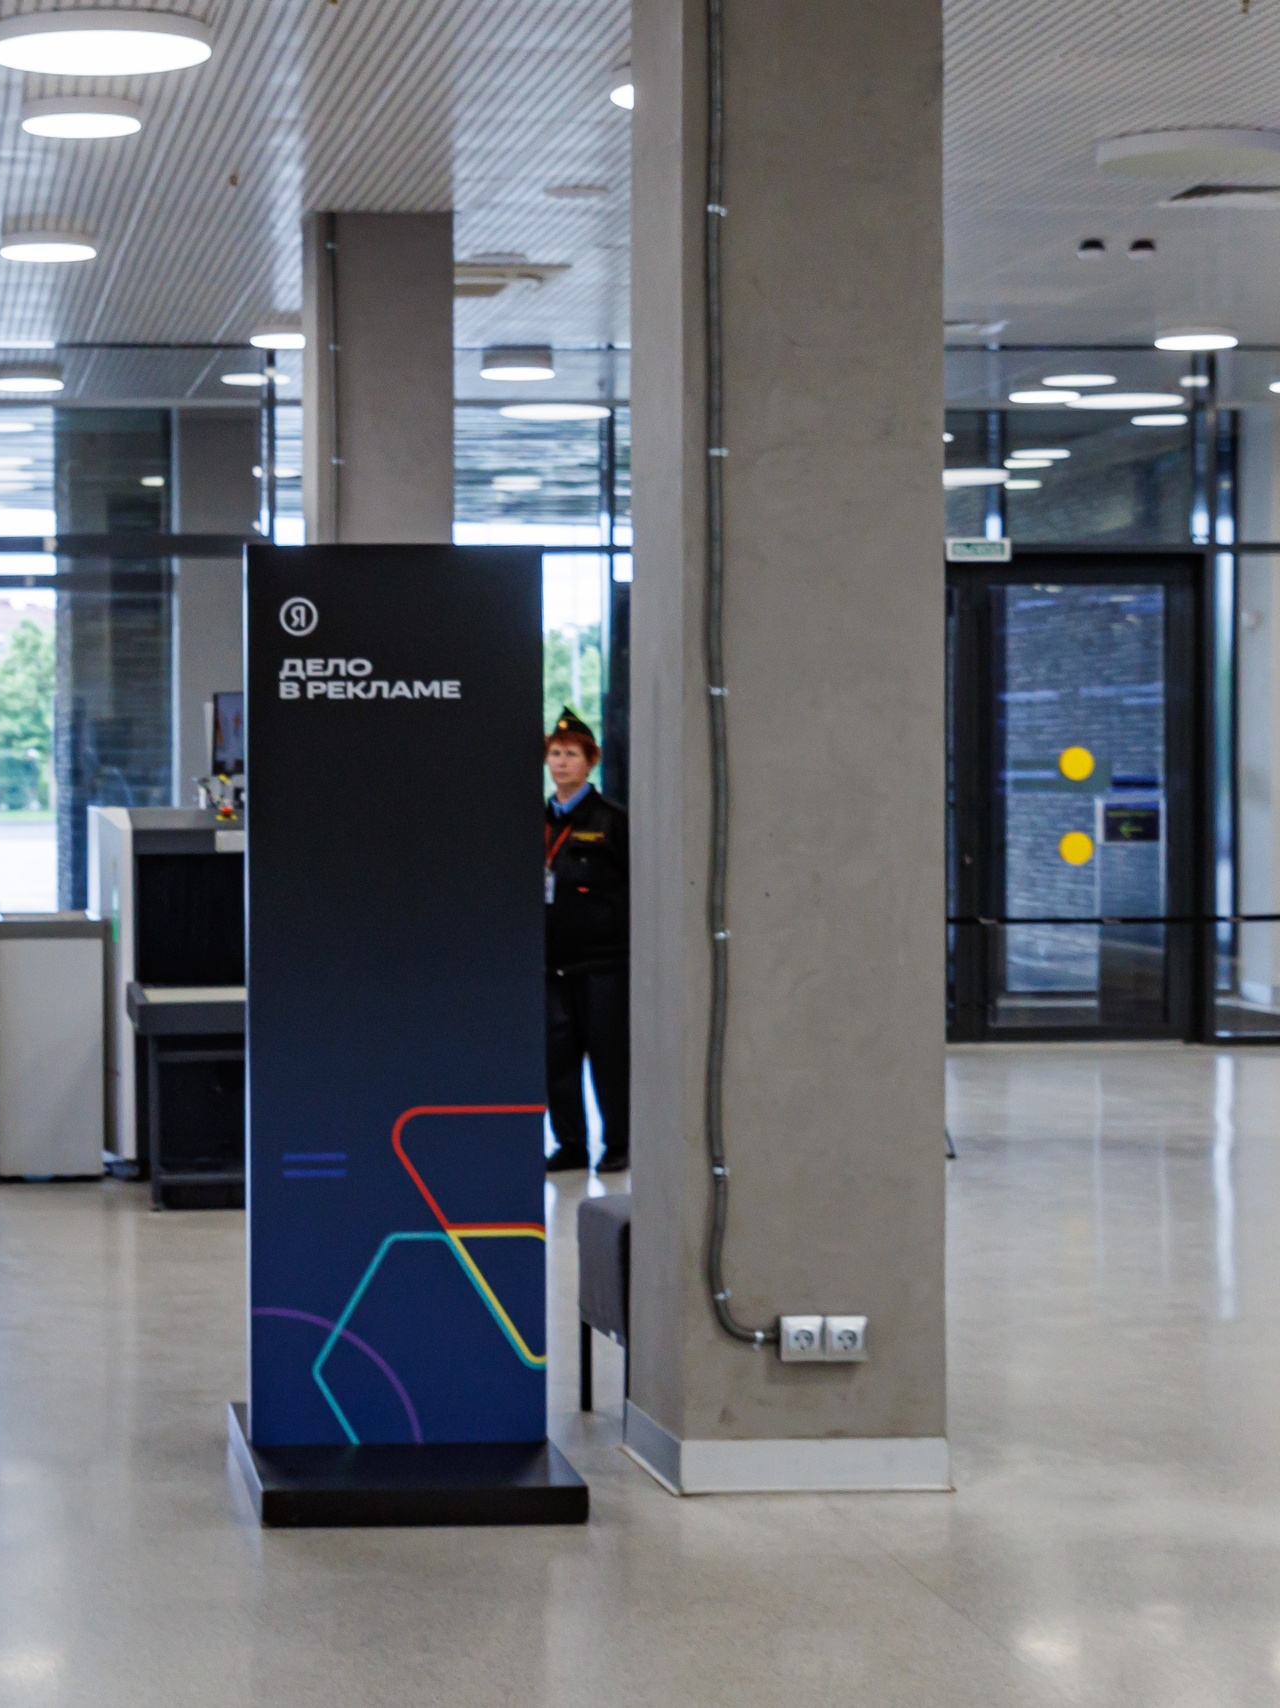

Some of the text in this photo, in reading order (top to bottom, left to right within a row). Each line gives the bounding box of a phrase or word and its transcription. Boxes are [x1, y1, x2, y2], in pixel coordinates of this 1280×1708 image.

[279, 658, 373, 680] ДЕЛО
[279, 680, 462, 699] В РЕКЛАМЕ
